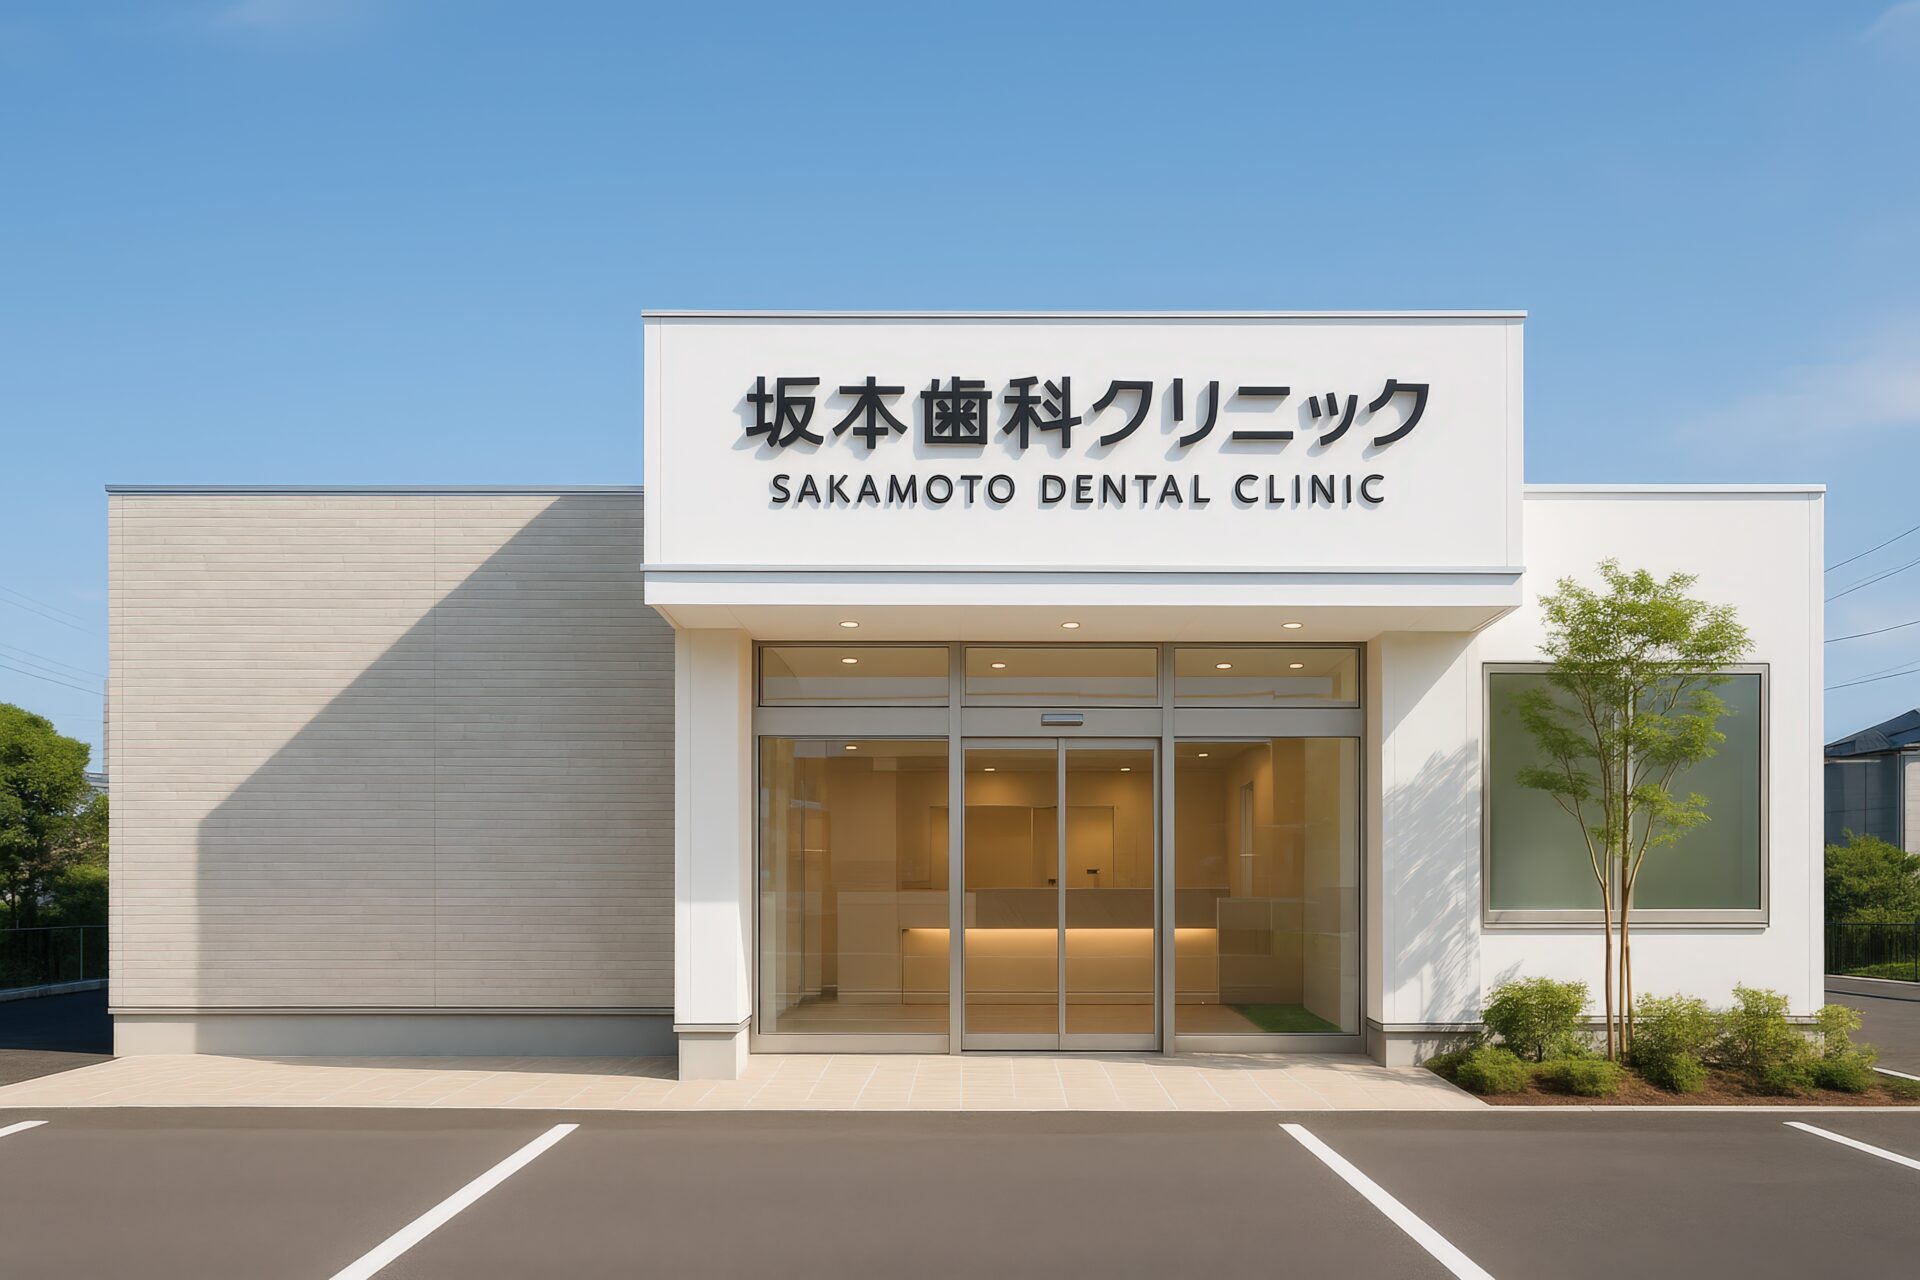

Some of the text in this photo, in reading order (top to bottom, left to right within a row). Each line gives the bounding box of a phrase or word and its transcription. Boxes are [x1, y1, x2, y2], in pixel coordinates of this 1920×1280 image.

[746, 376, 1430, 450] 坂本歯科クリニック
[772, 474, 1385, 504] SAKAMOTO DENTAL CLINIC
